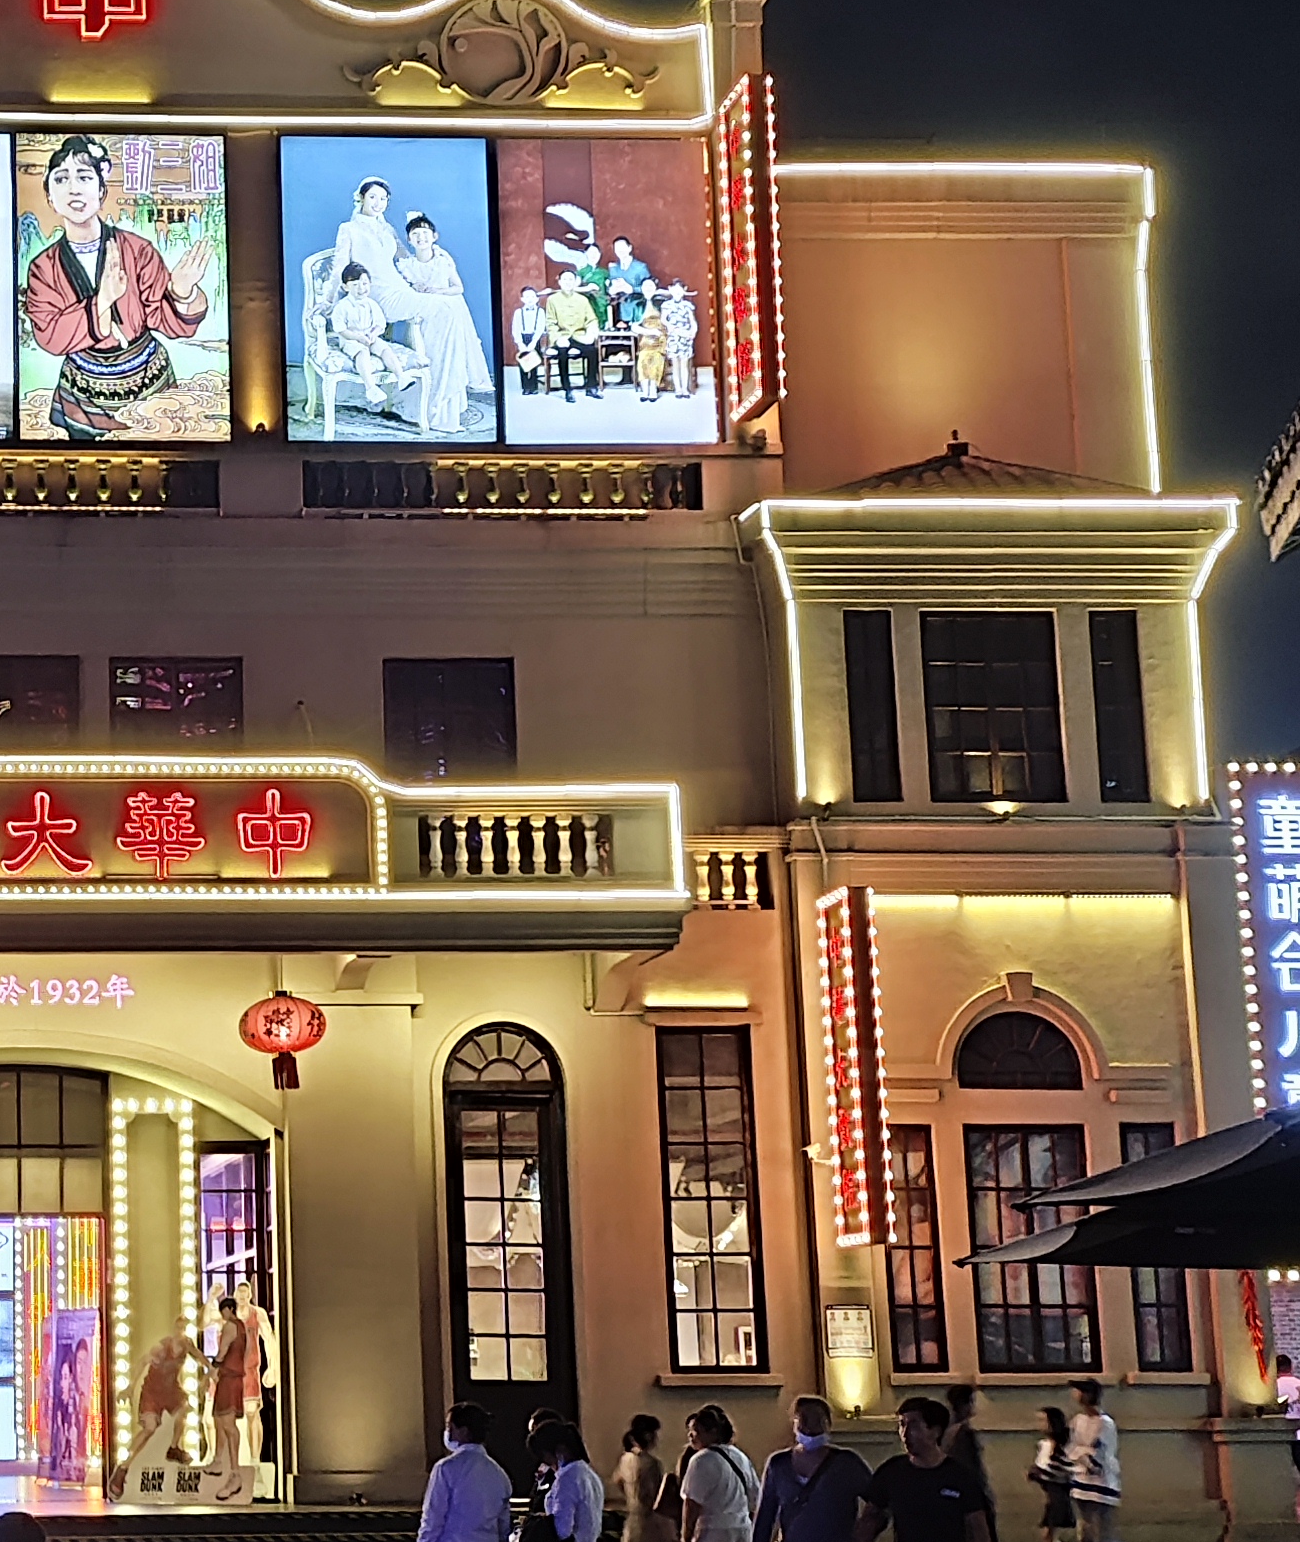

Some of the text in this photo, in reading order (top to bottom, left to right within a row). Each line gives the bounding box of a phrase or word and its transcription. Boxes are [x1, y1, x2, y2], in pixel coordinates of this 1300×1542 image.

[141, 1471, 165, 1481] SLAM
[140, 1480, 163, 1493] DUNK
[176, 1480, 200, 1493] DUNK
